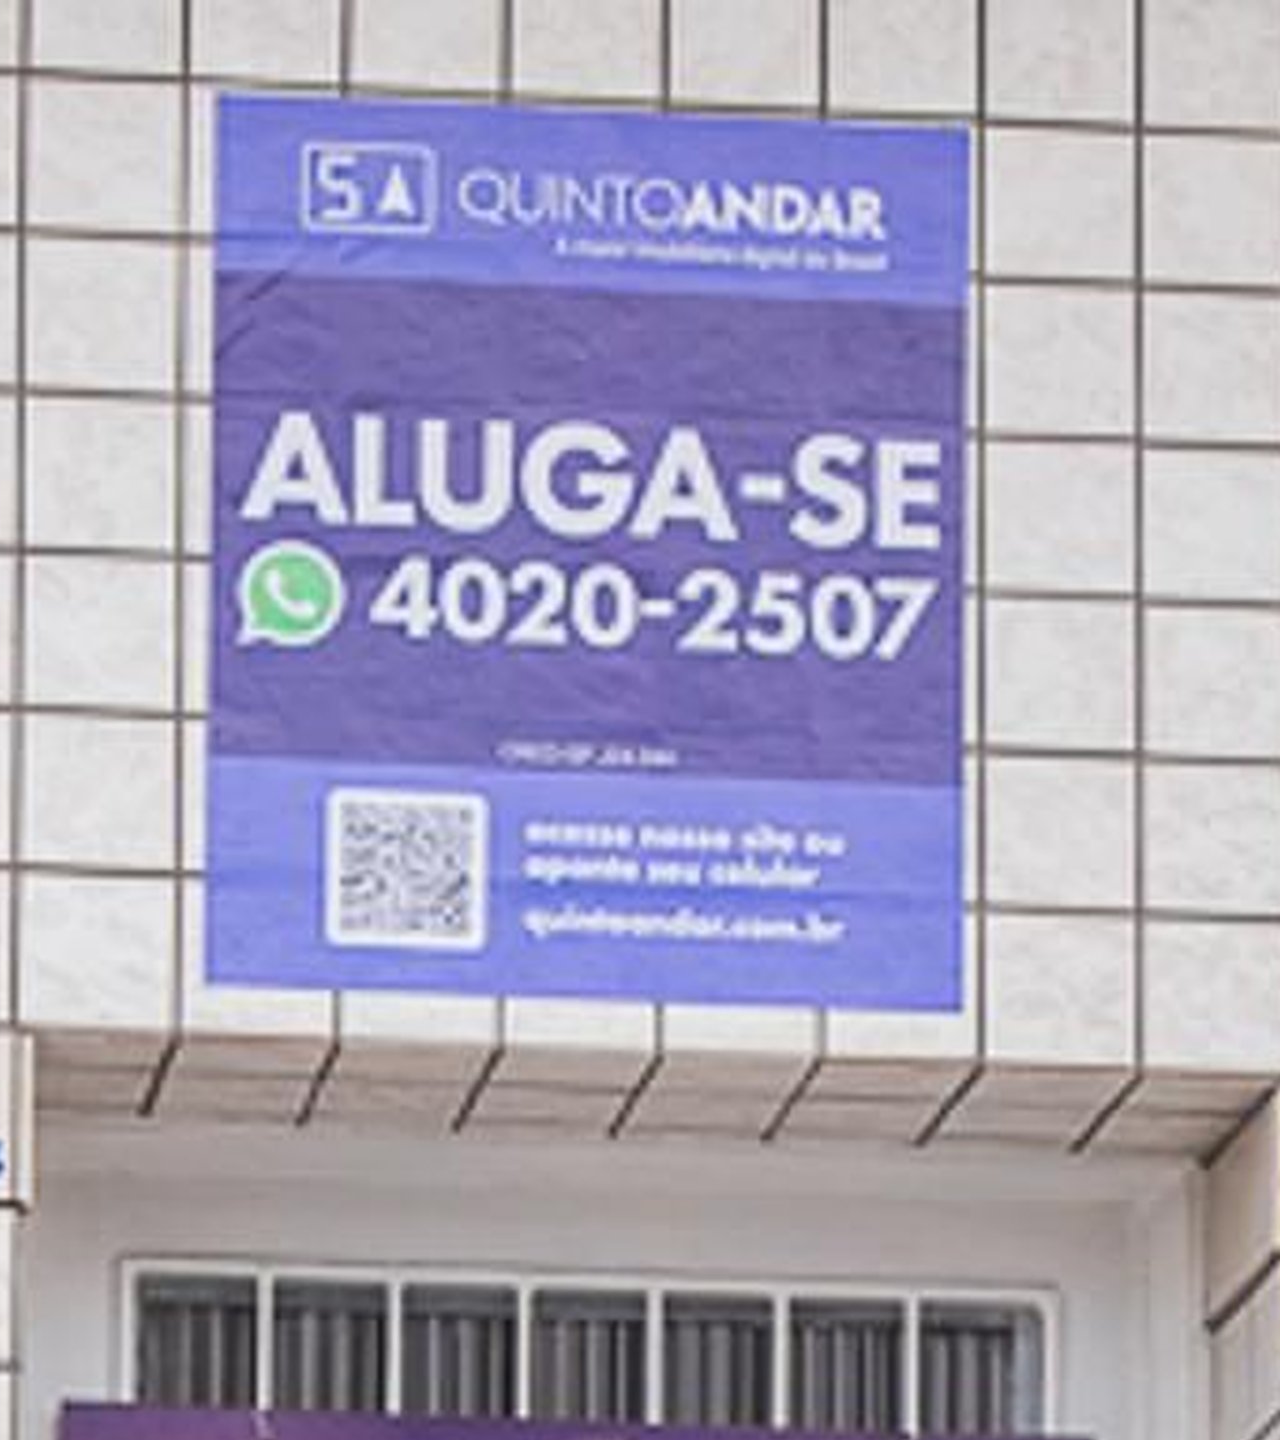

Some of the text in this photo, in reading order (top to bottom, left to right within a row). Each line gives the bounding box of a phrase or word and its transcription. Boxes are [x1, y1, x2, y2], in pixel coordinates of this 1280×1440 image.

[457, 166, 887, 241] QUINTOANDAR
[239, 411, 944, 551] ALUGA-SE
[368, 556, 941, 660] 4020-2507
